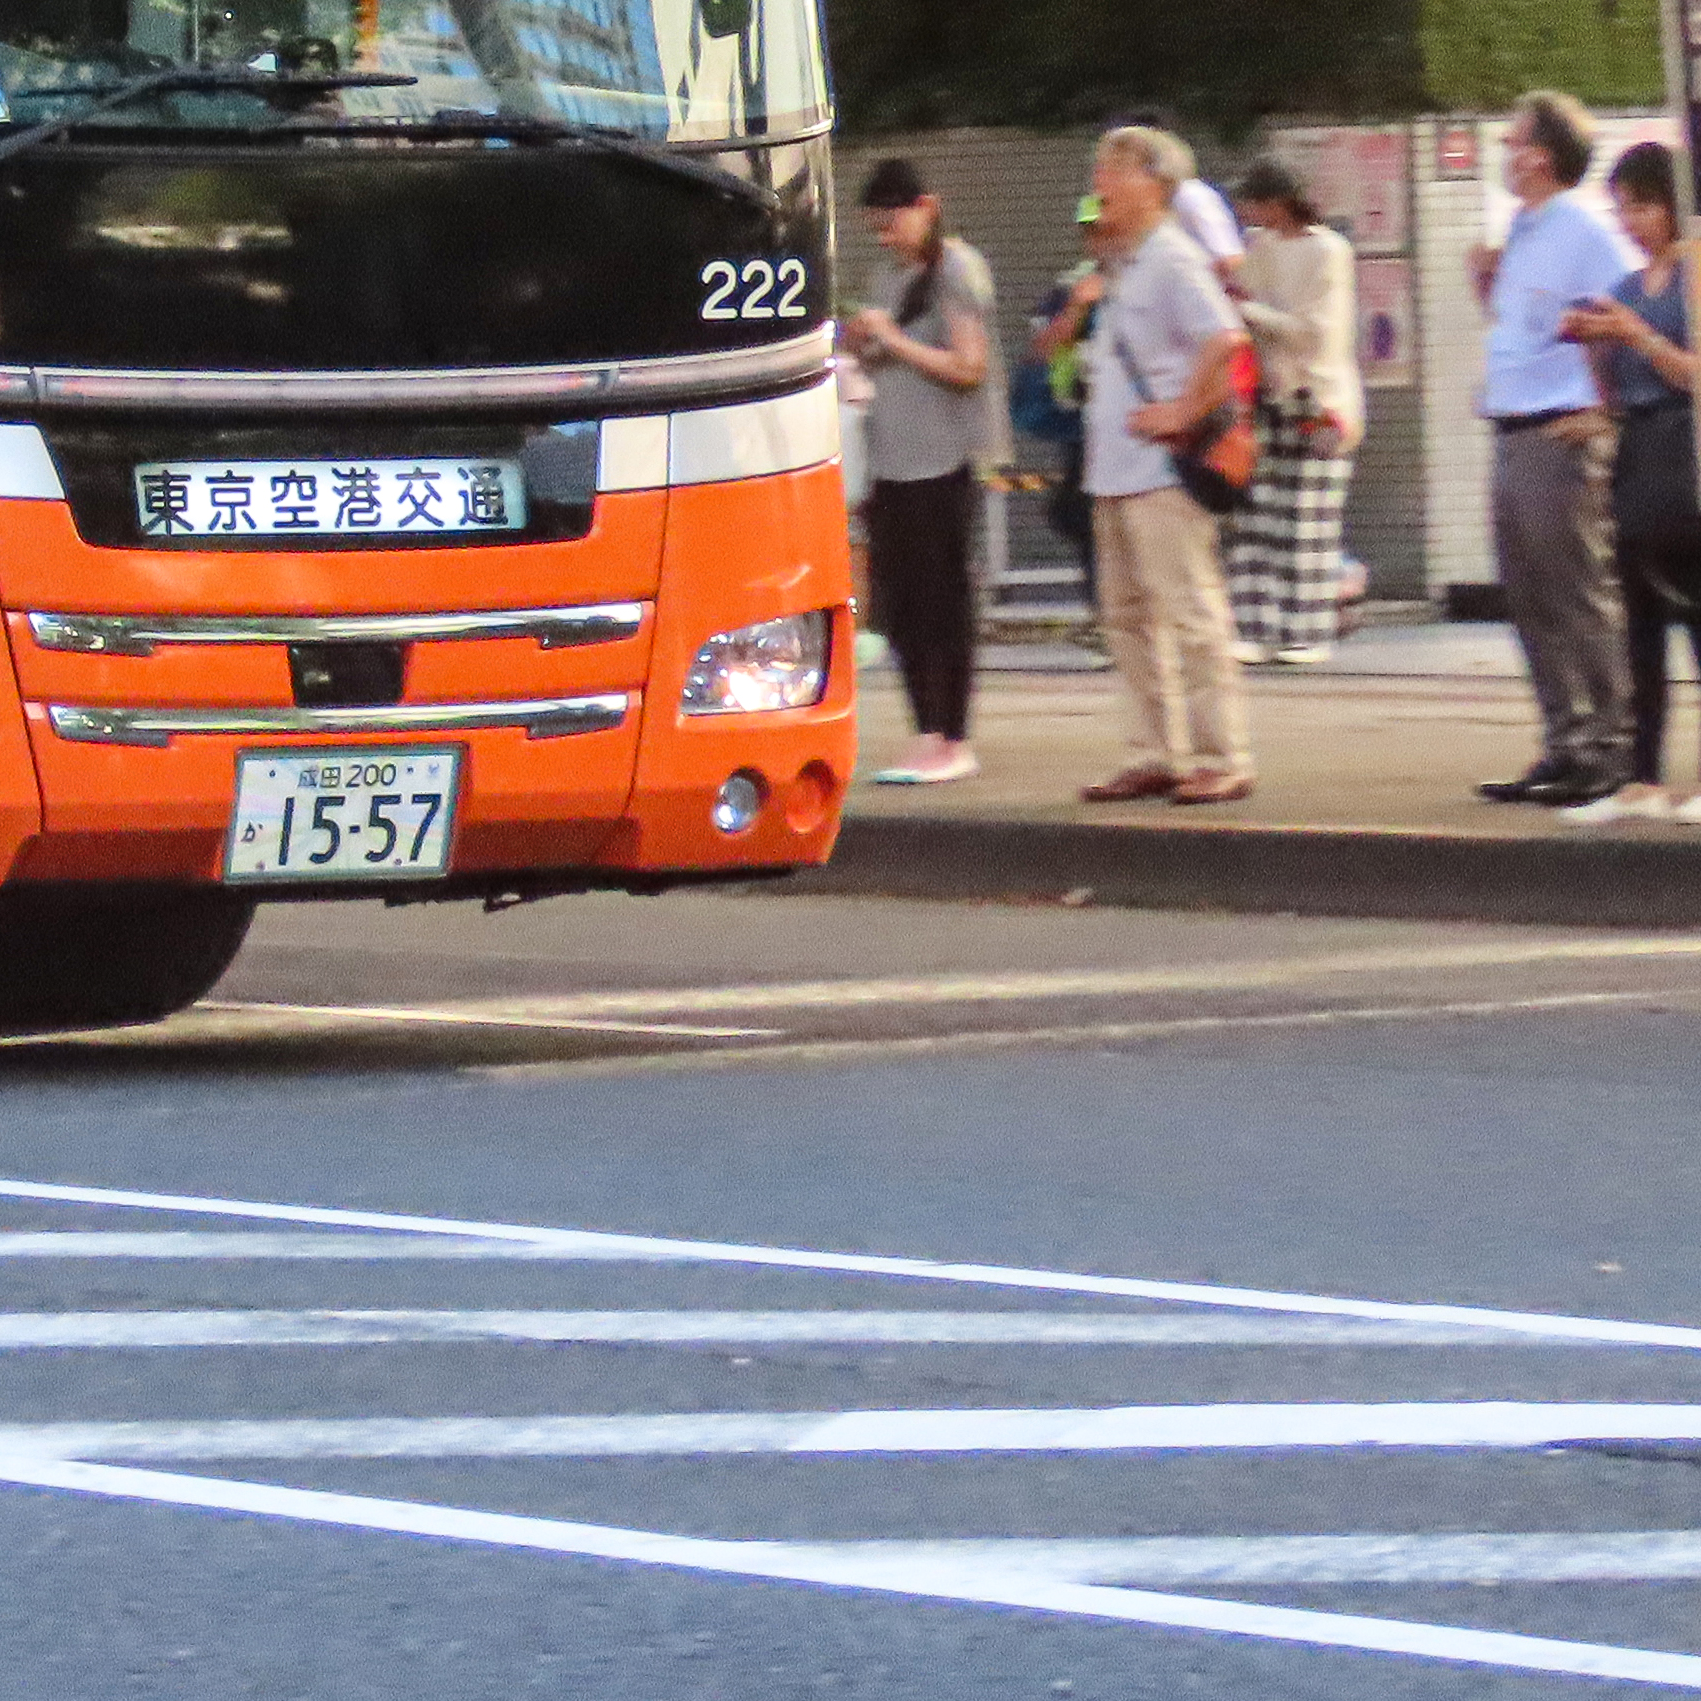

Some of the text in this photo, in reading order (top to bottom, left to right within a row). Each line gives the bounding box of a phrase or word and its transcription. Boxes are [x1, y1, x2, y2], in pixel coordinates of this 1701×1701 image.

[700, 257, 808, 320] 222
[139, 466, 509, 536] 東京空港交通
